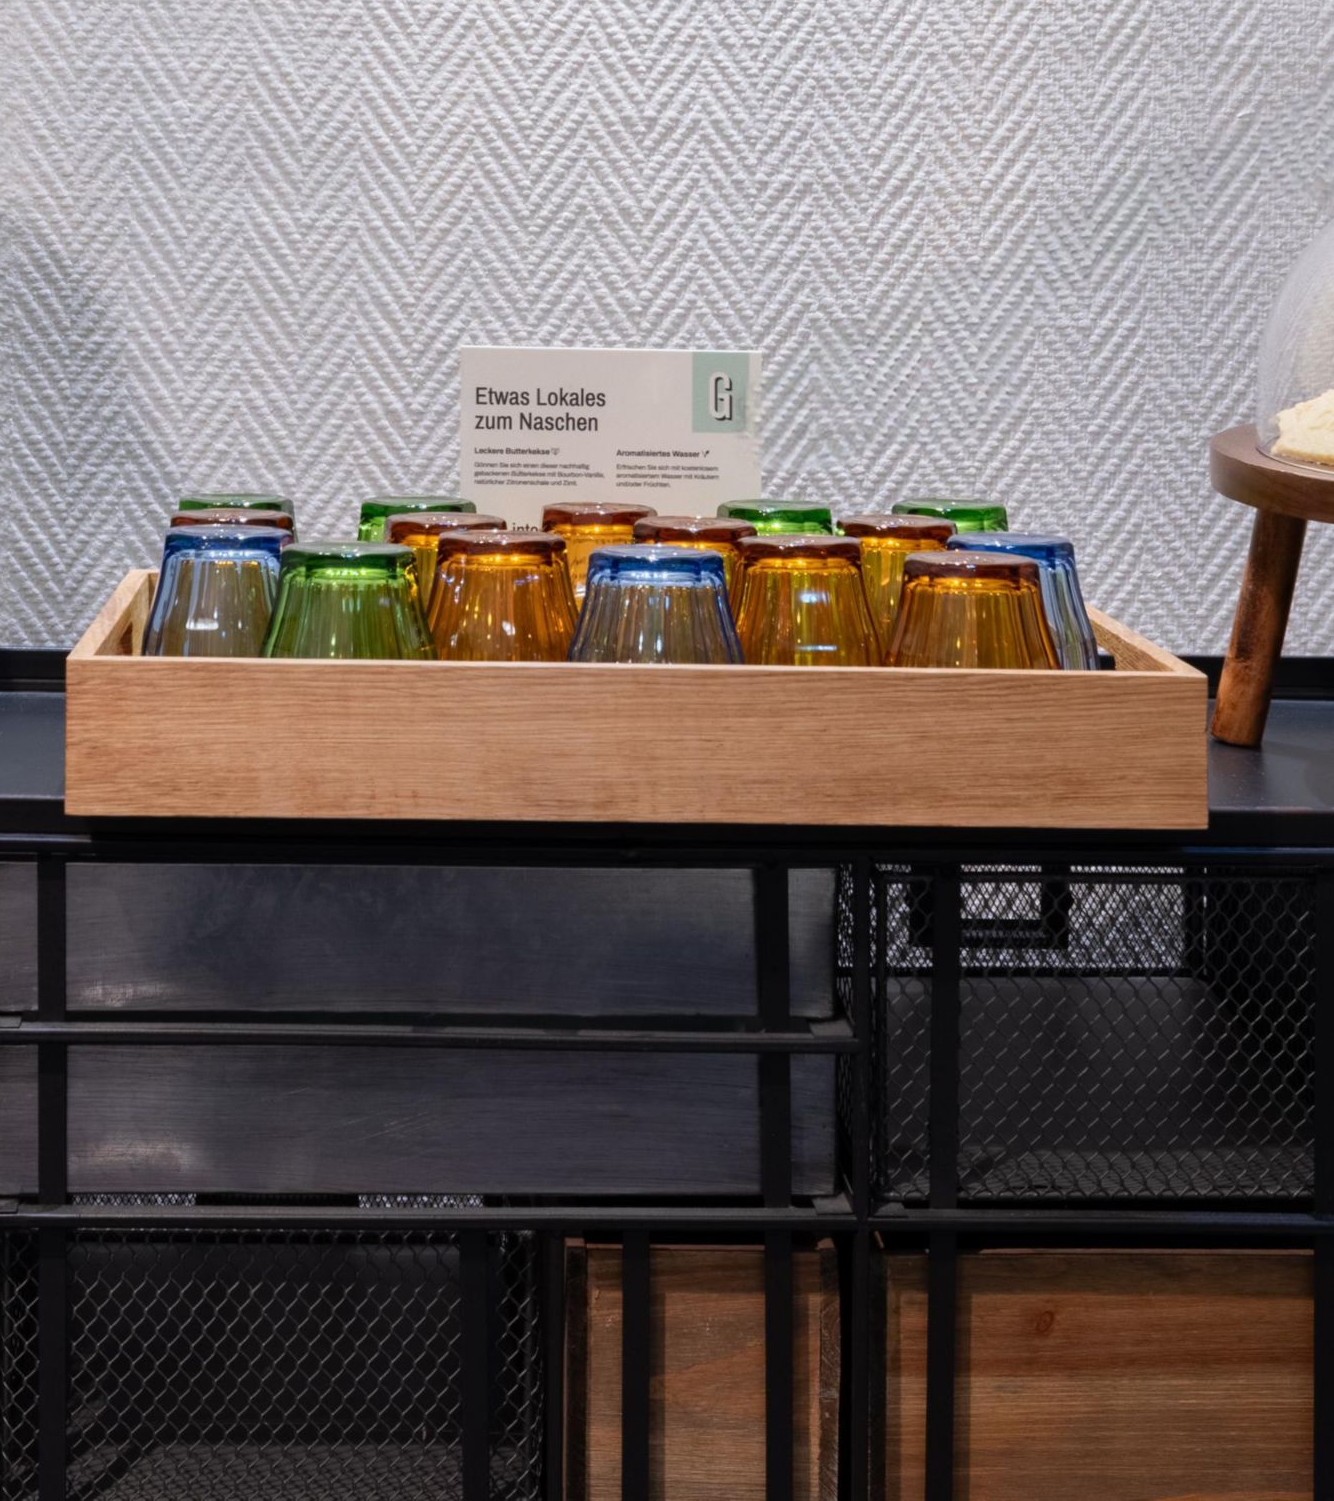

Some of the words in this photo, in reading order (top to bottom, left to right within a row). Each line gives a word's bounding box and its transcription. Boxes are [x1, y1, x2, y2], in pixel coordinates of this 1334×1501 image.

[475, 386, 530, 406] Etwas
[536, 387, 607, 408] Lokales
[474, 414, 513, 431] zum
[519, 411, 599, 432] Naschen
[505, 447, 550, 455] Butterkekse
[616, 449, 670, 457] Aromatisiertes
